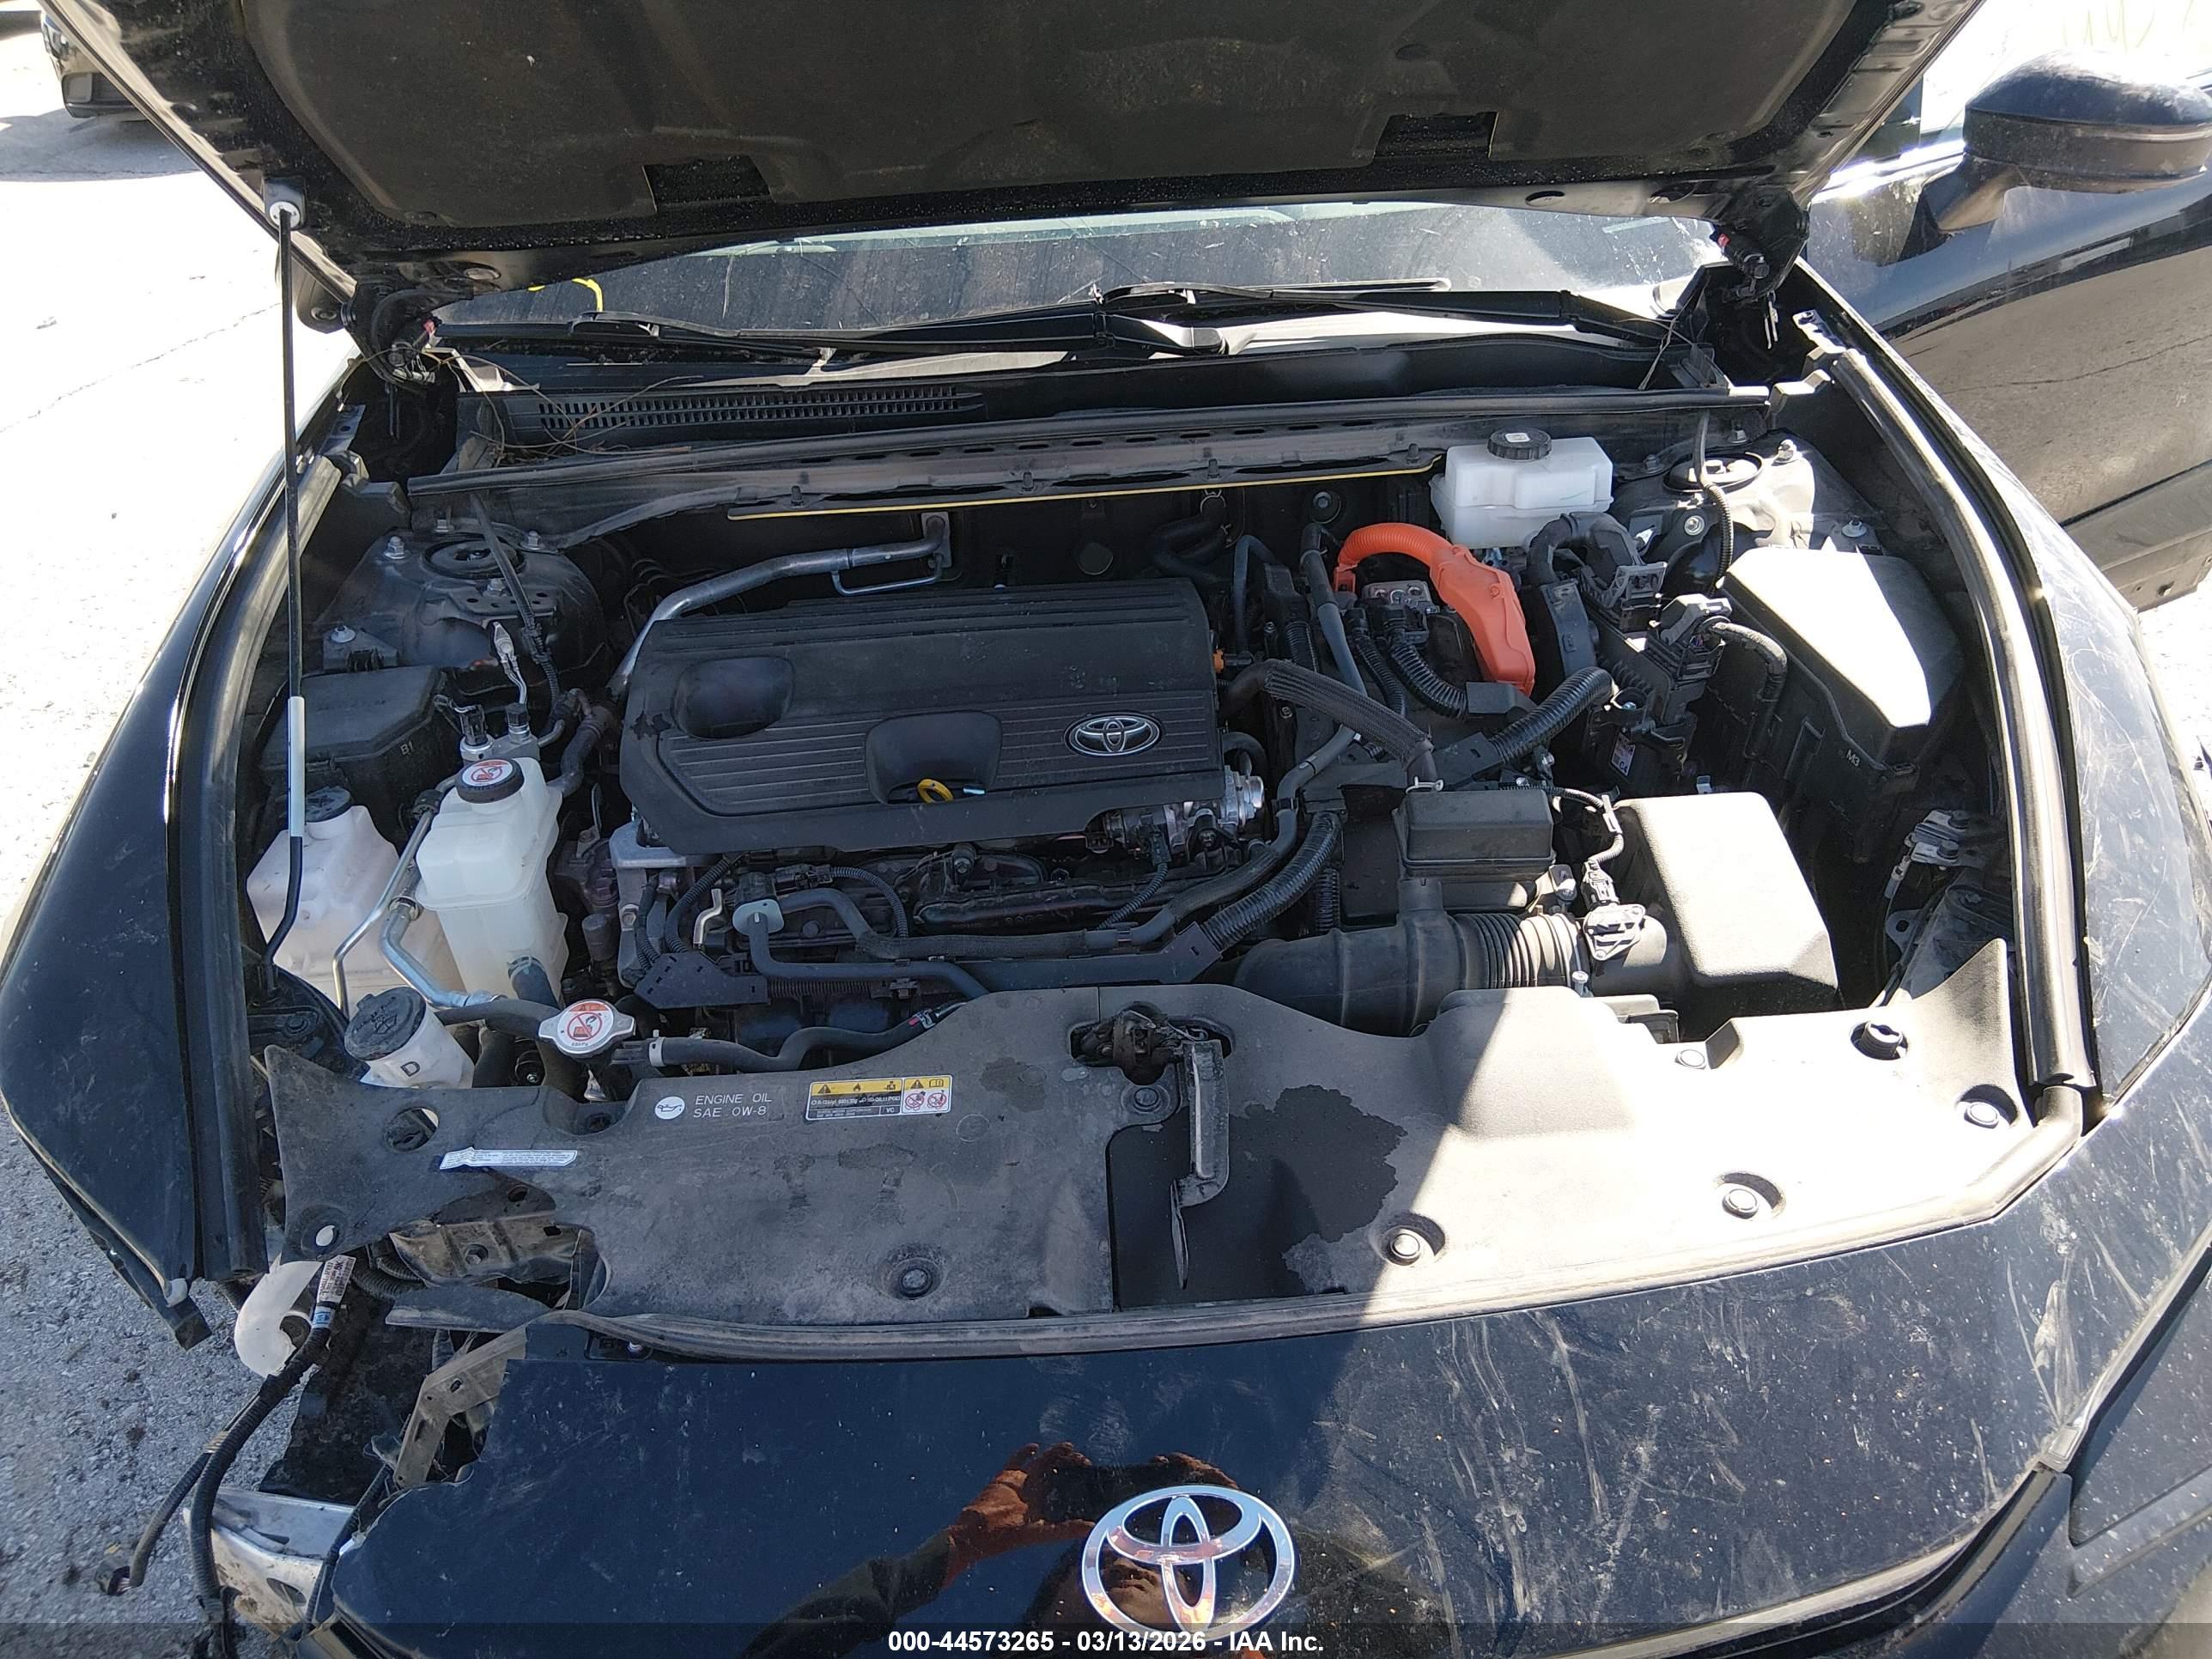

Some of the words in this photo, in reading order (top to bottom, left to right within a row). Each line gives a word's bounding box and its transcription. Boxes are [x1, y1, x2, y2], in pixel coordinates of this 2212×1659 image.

[1846, 749, 1861, 767] M3
[400, 1060, 421, 1077] D
[695, 1093, 744, 1105] ENGINE
[752, 1093, 773, 1103] OIL
[693, 1107, 722, 1118] SAE
[732, 1105, 767, 1117] 0W-8
